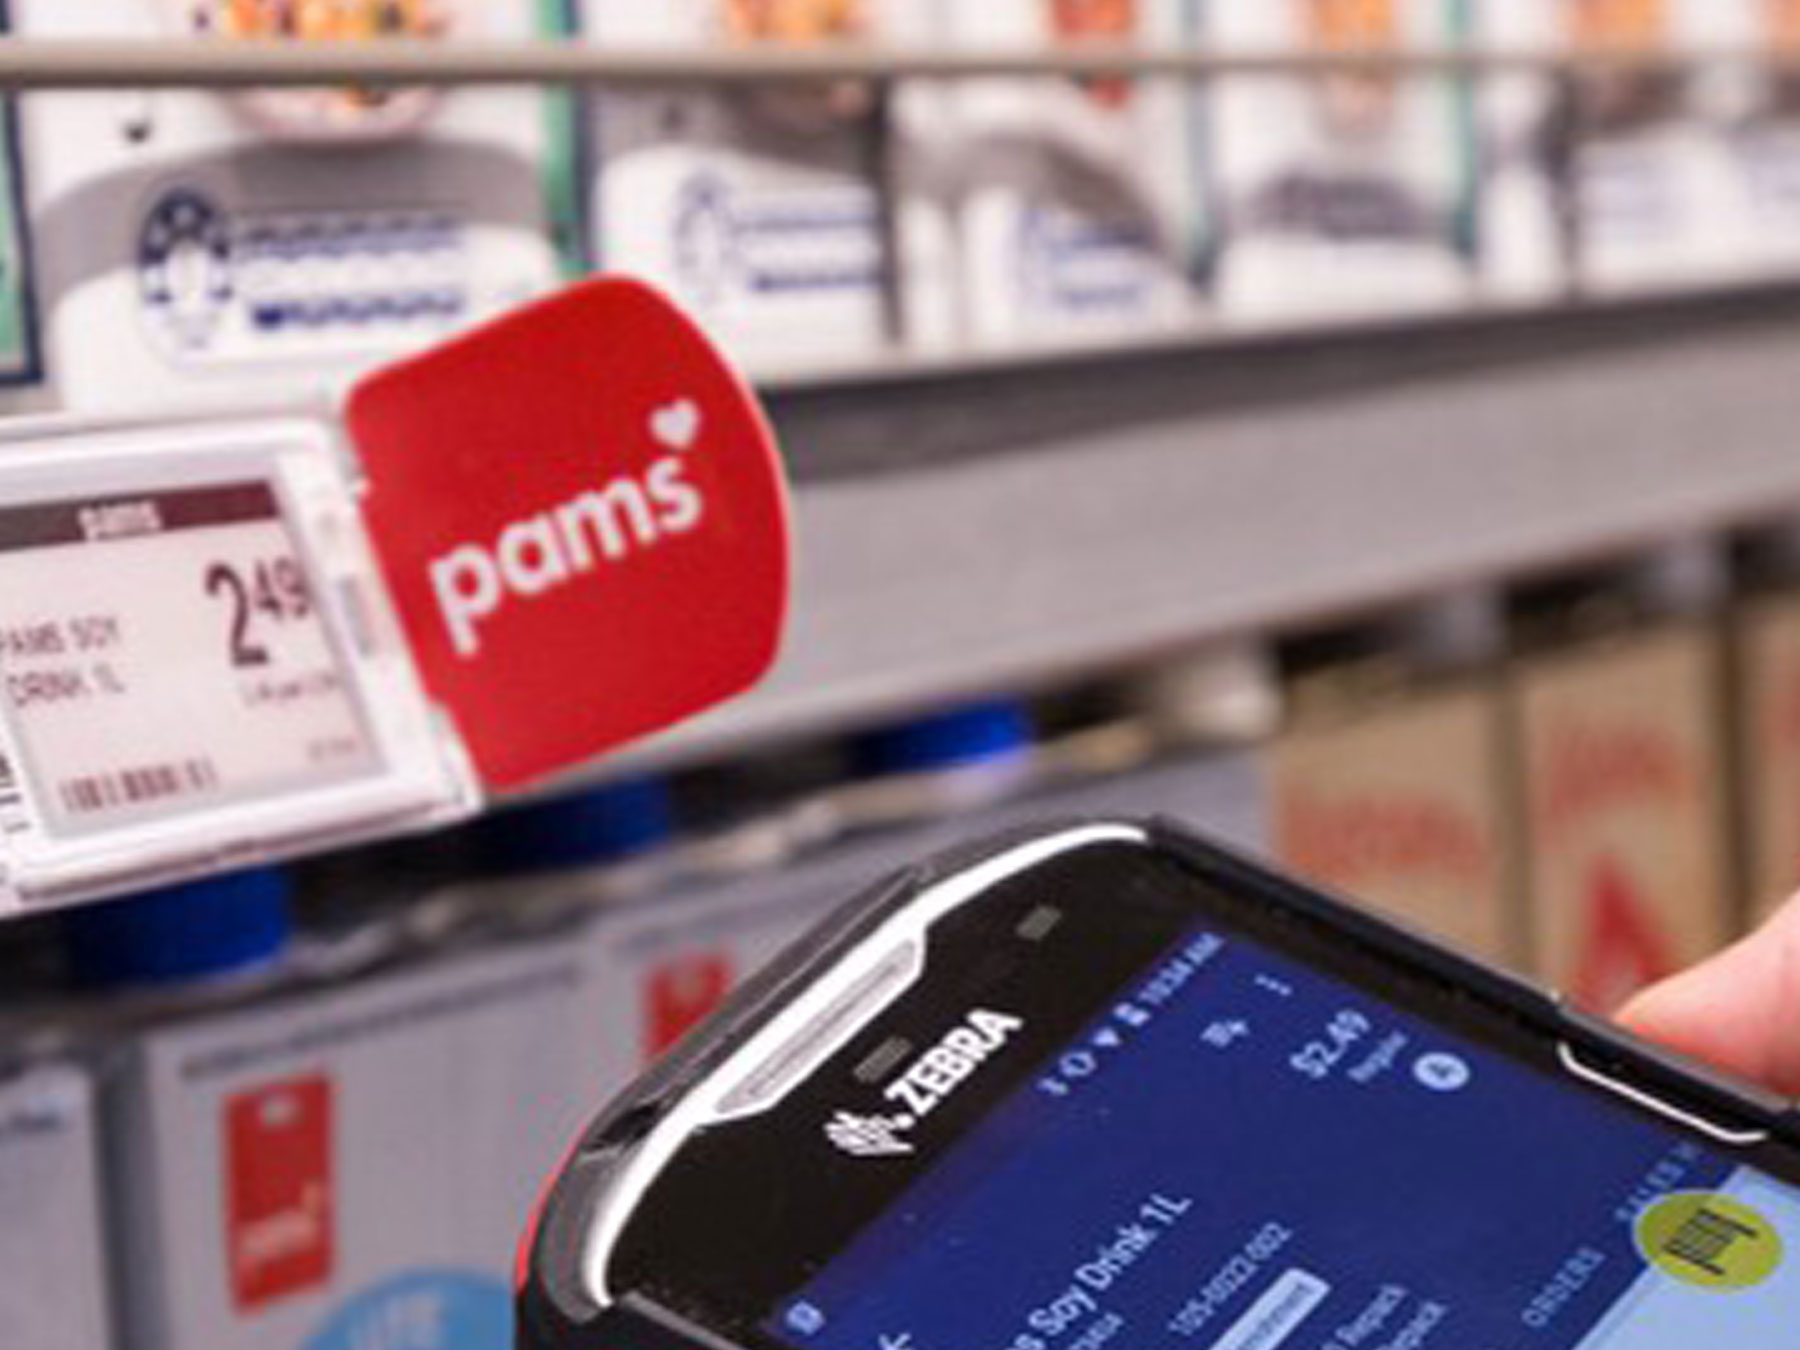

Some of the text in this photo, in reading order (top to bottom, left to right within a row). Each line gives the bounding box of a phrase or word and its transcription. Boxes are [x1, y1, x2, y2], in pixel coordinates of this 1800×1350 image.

[429, 454, 703, 656] pams
[884, 1009, 1023, 1116] ZEBRA
[1289, 1010, 1369, 1077] $2.49
[1027, 1285, 1097, 1335] Soy
[1074, 1224, 1156, 1290] Drink
[1139, 1193, 1192, 1224] 1L
[1520, 1247, 1604, 1327] ORDERS
[1334, 1284, 1406, 1345] Repack
